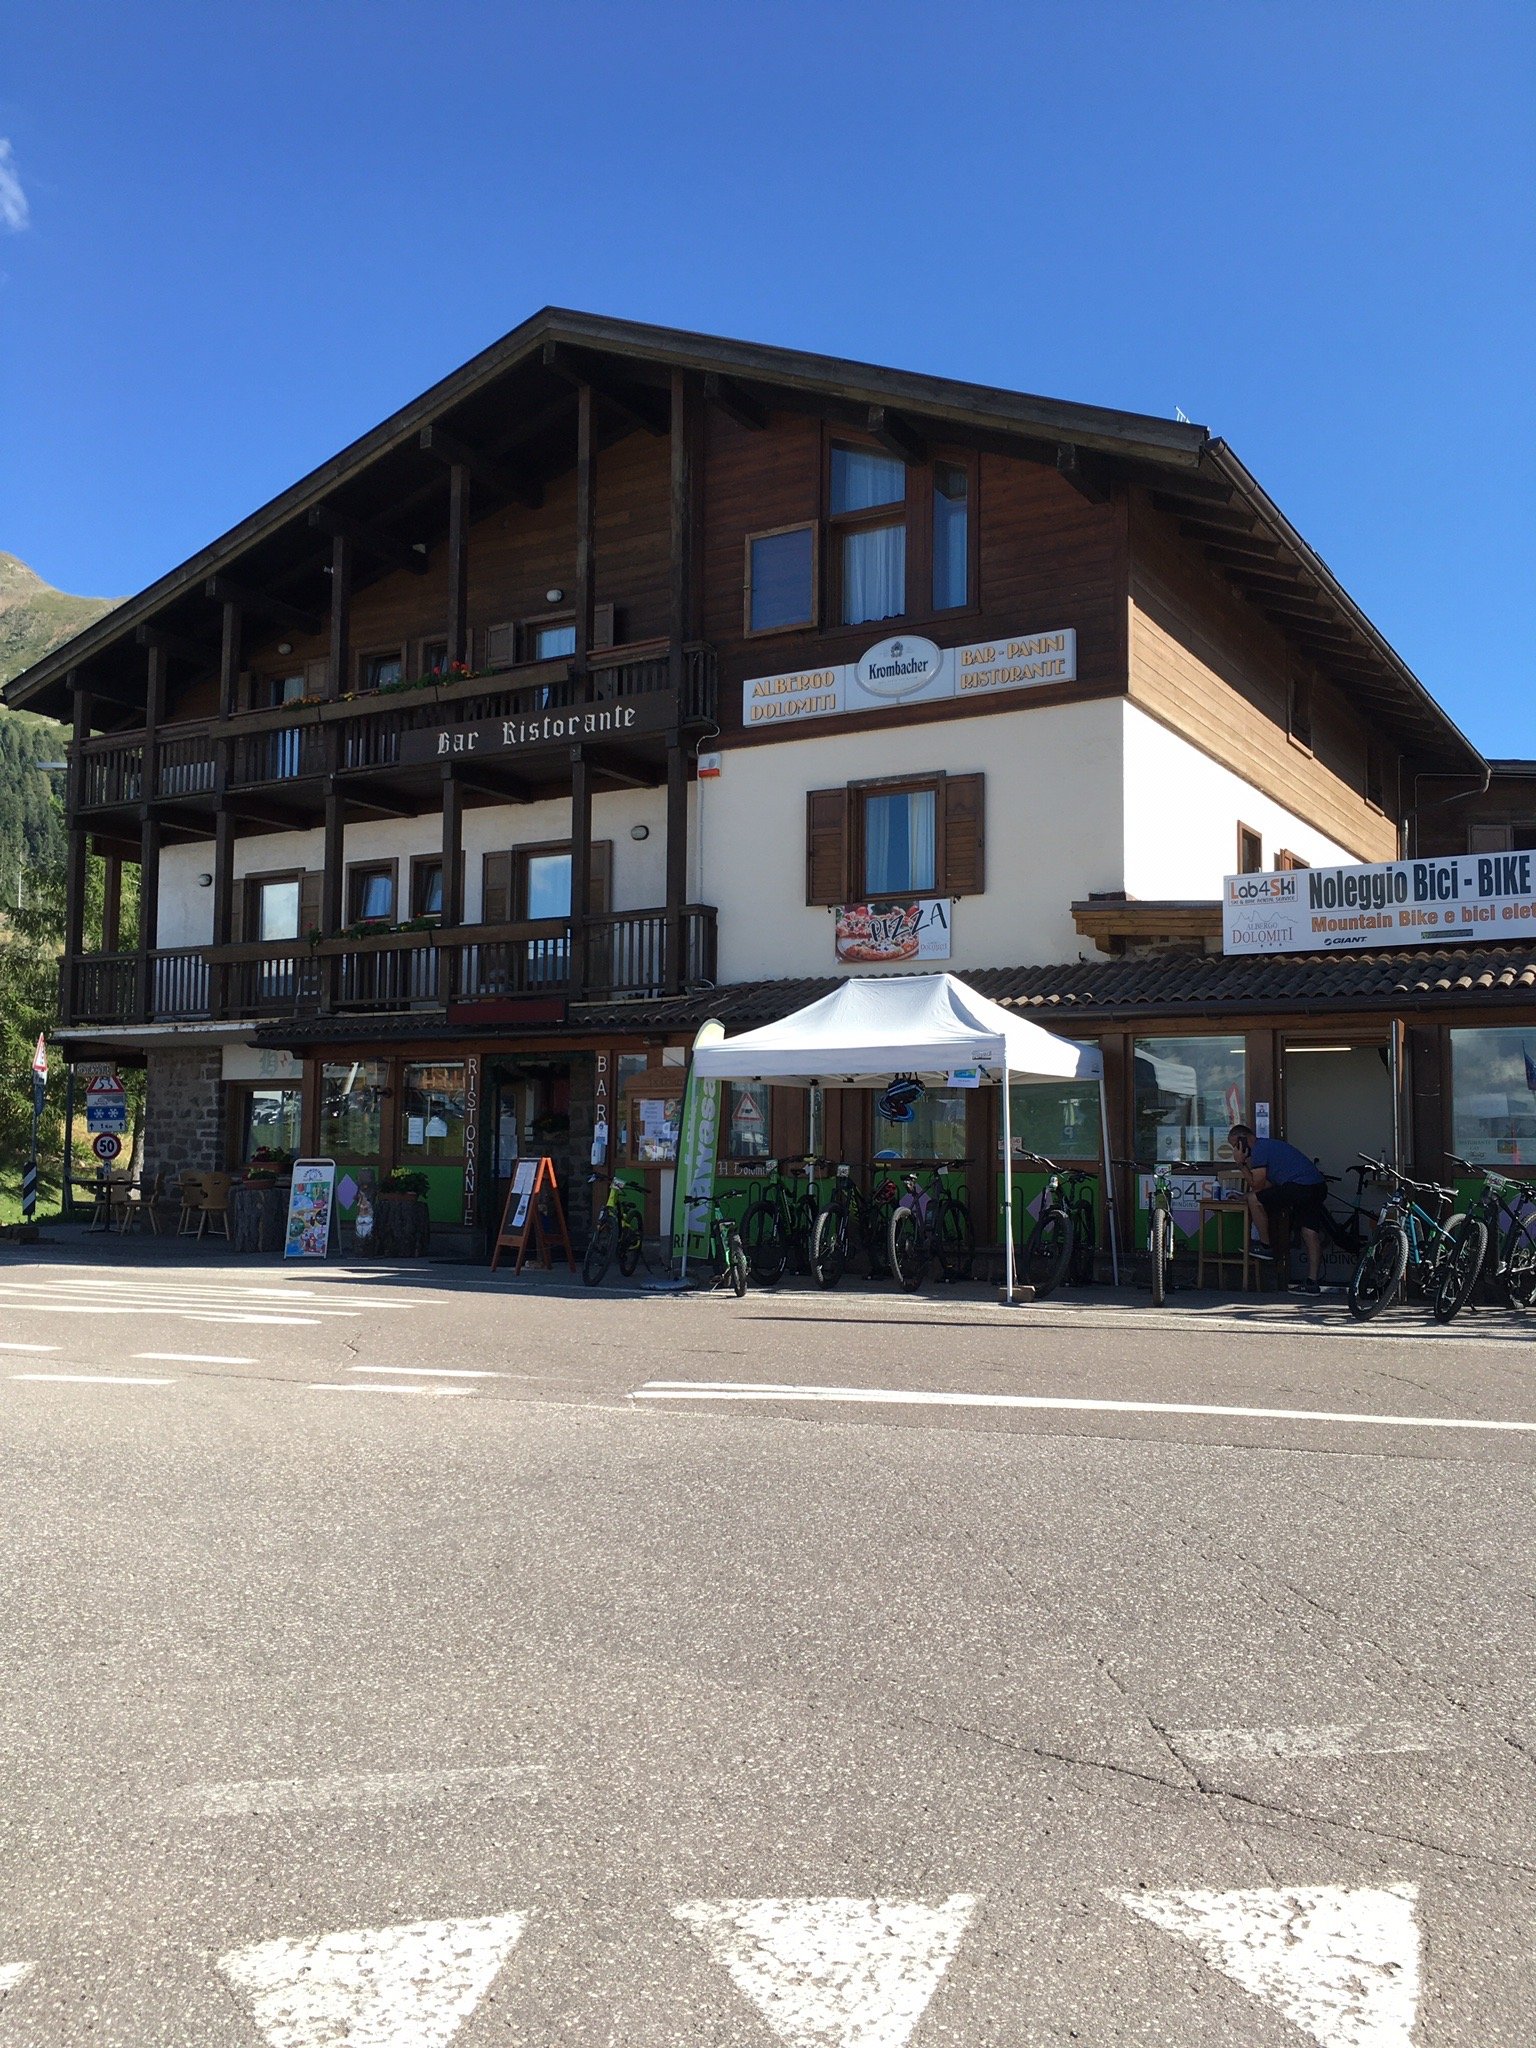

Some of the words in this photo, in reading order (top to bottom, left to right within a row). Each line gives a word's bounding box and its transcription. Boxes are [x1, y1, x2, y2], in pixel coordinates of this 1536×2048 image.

[961, 648, 995, 666] BAR
[1007, 634, 1065, 659] PANINI
[868, 657, 929, 680] Krombacher
[960, 658, 1066, 690] RISTORANTE
[751, 670, 836, 698] ALBERGO
[750, 693, 836, 721] DOLOMITI
[436, 730, 480, 755] Bar
[502, 704, 636, 746] Ristorante
[1230, 876, 1295, 899] Lab4Ski
[1308, 866, 1407, 911] Noleggio
[1413, 860, 1459, 902] Bici
[1477, 854, 1532, 897] BIKE
[867, 903, 948, 942] PIZZA
[1247, 922, 1278, 931] ALBERGO
[1311, 910, 1393, 933] Mountain
[1399, 908, 1439, 927] Bike
[1444, 911, 1455, 924] e
[1461, 903, 1496, 923] bici
[1232, 927, 1293, 944] DOLOMITI
[1332, 936, 1367, 945] GIANT
[597, 1055, 608, 1121] BAR
[99, 1140, 115, 1153] 50
[464, 1058, 478, 1226] RISTORANTE
[717, 1160, 729, 1176] H
